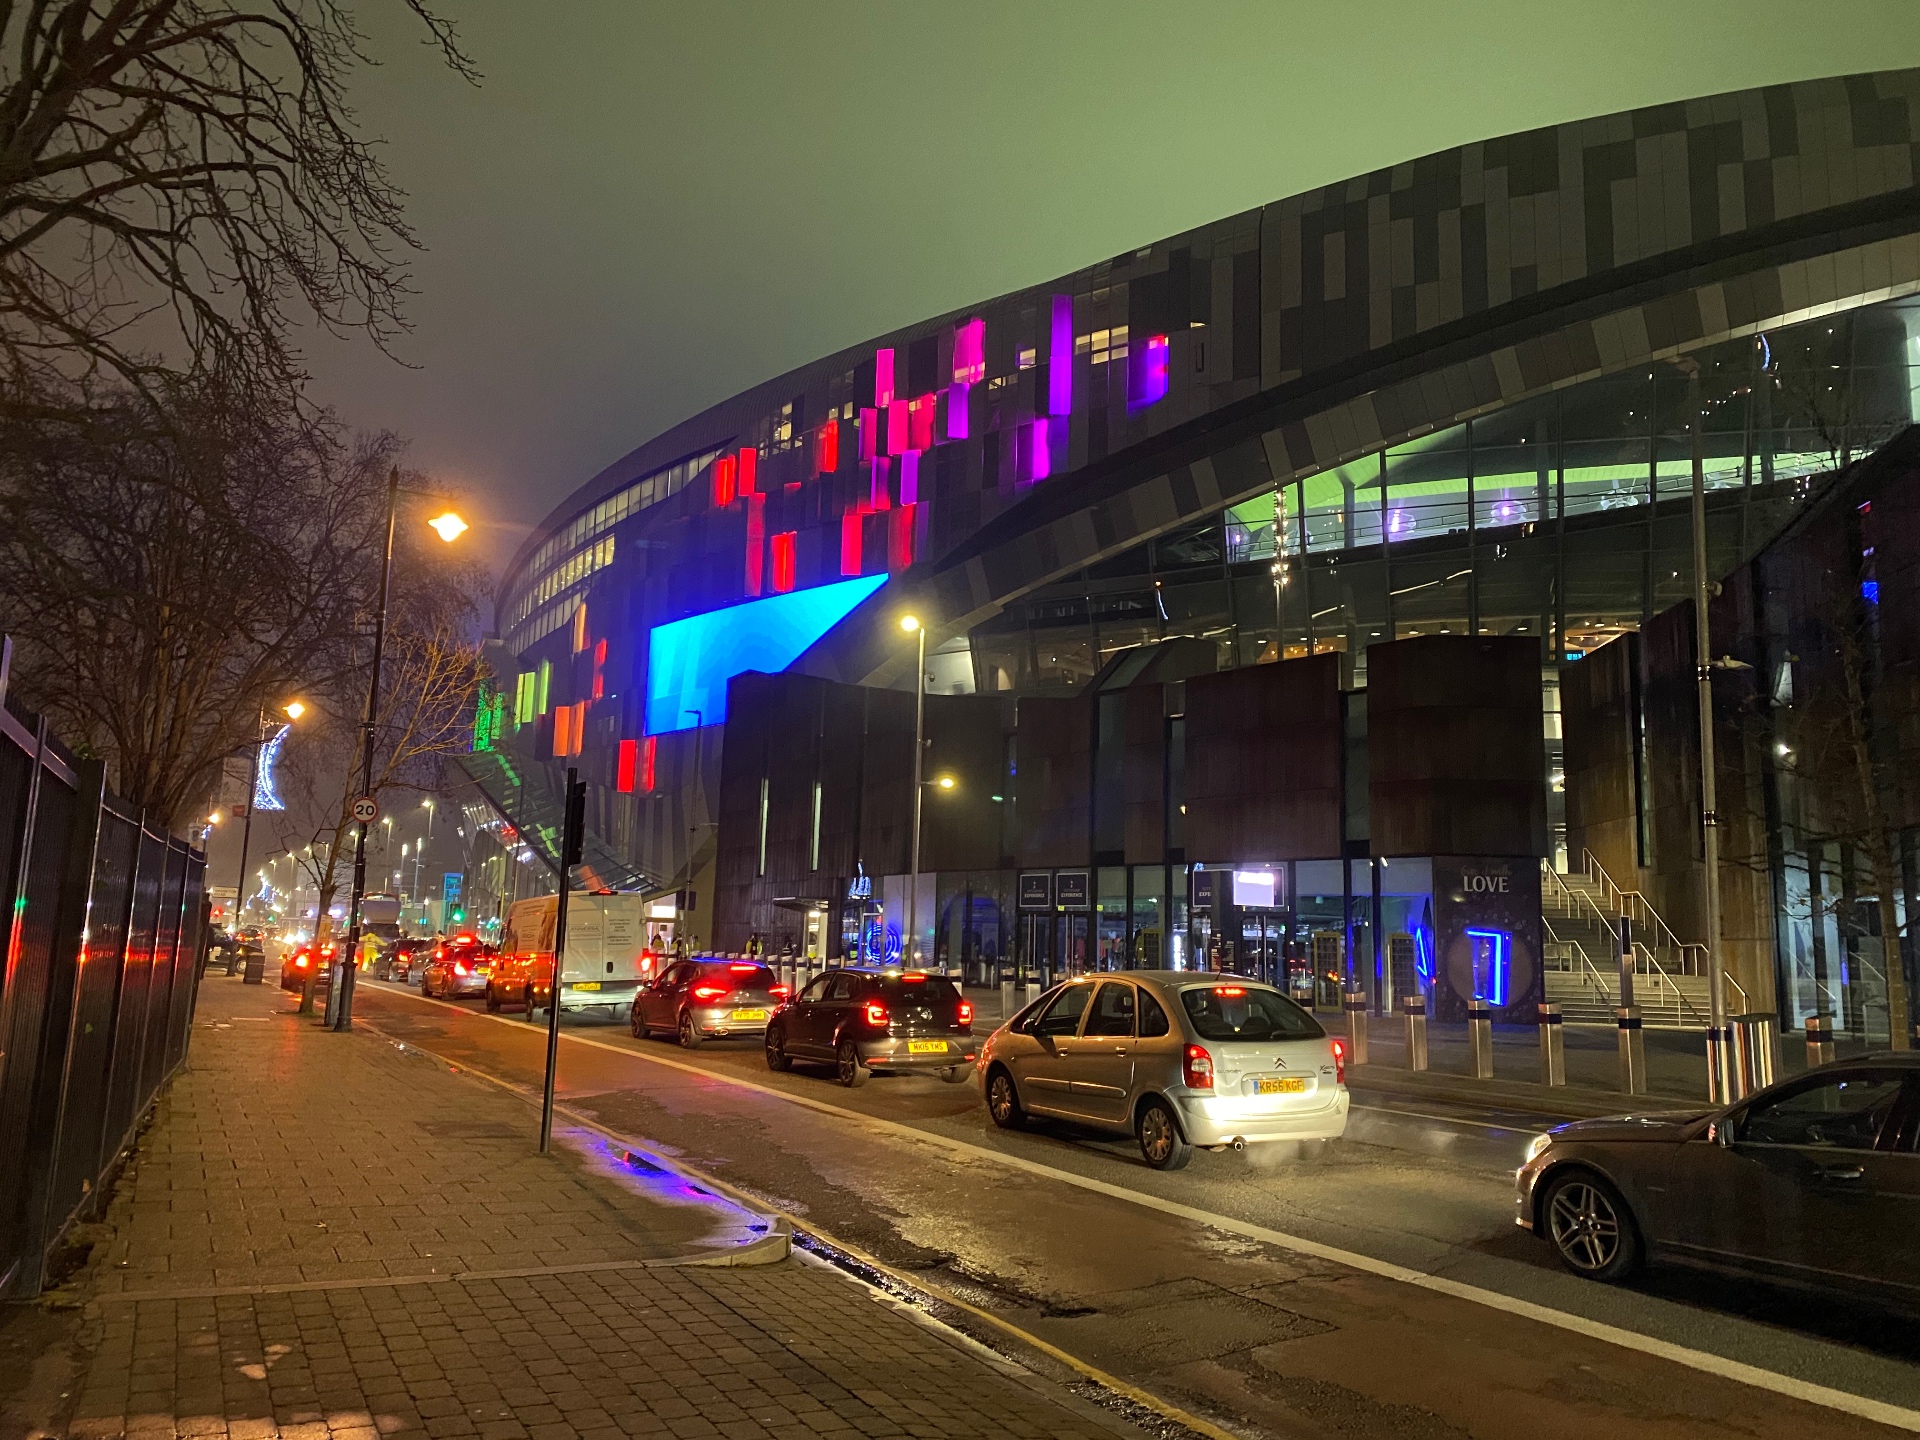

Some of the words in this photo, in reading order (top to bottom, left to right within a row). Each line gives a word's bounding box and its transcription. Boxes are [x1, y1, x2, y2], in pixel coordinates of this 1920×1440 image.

[355, 804, 375, 816] 20
[1463, 875, 1509, 893] LOVE
[1259, 1081, 1284, 1093] KR56
[1285, 1080, 1302, 1092] KGF
